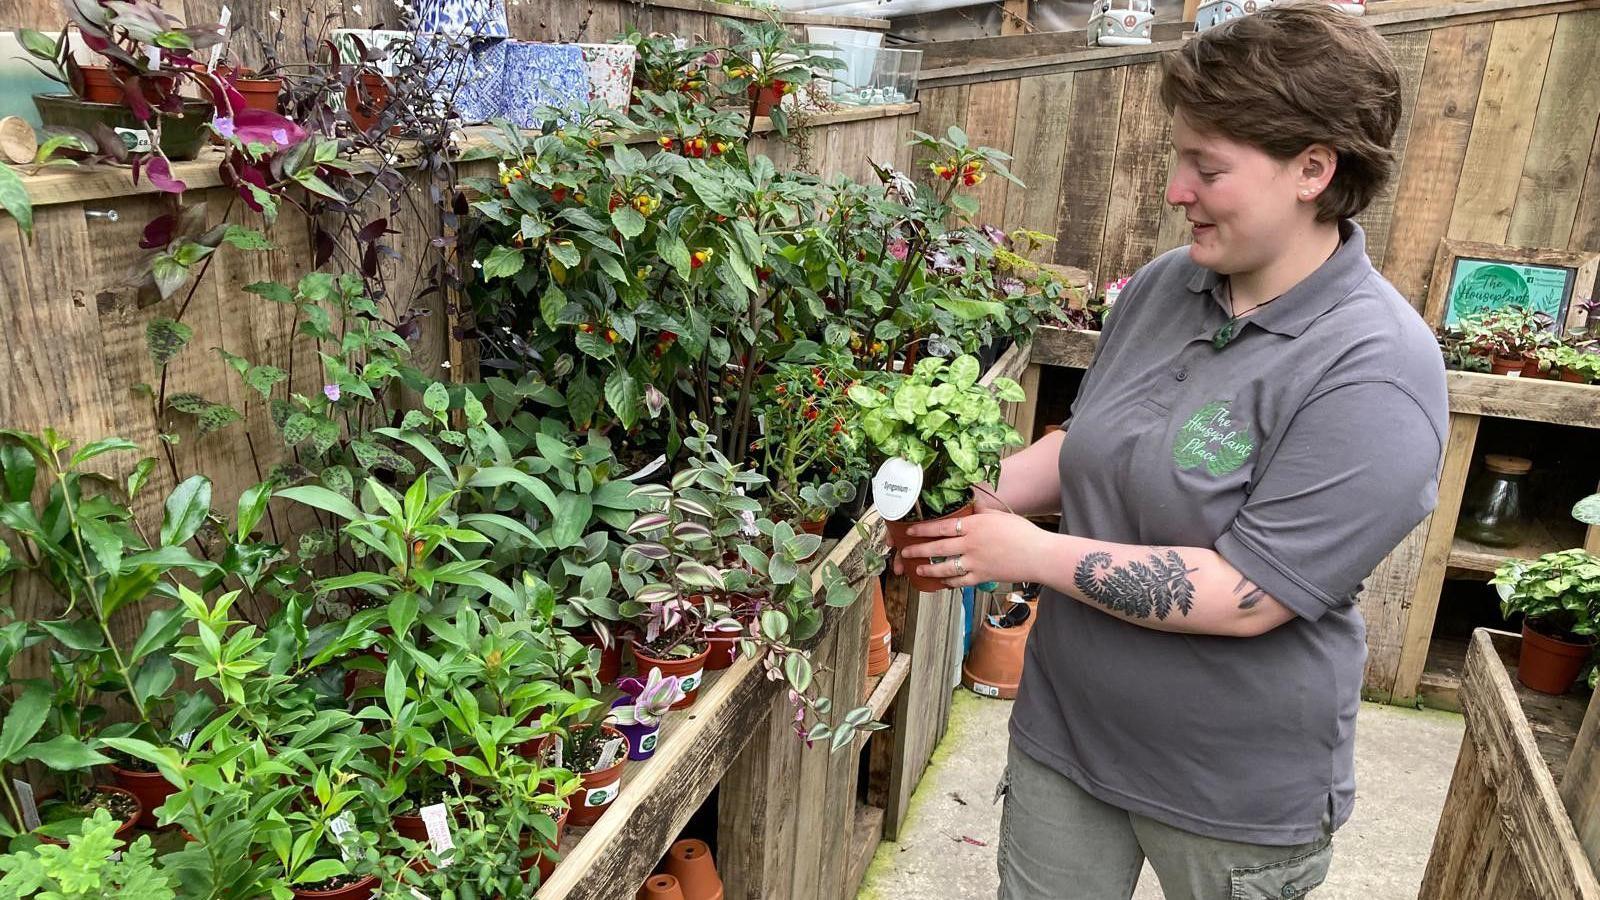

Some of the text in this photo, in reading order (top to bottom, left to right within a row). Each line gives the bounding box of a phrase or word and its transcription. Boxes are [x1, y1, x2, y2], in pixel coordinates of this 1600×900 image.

[1476, 274, 1504, 290] The
[1459, 284, 1529, 304] Houseplant
[1210, 407, 1232, 427] The
[1182, 413, 1254, 457] Houseplant
[1181, 438, 1217, 462] Place
